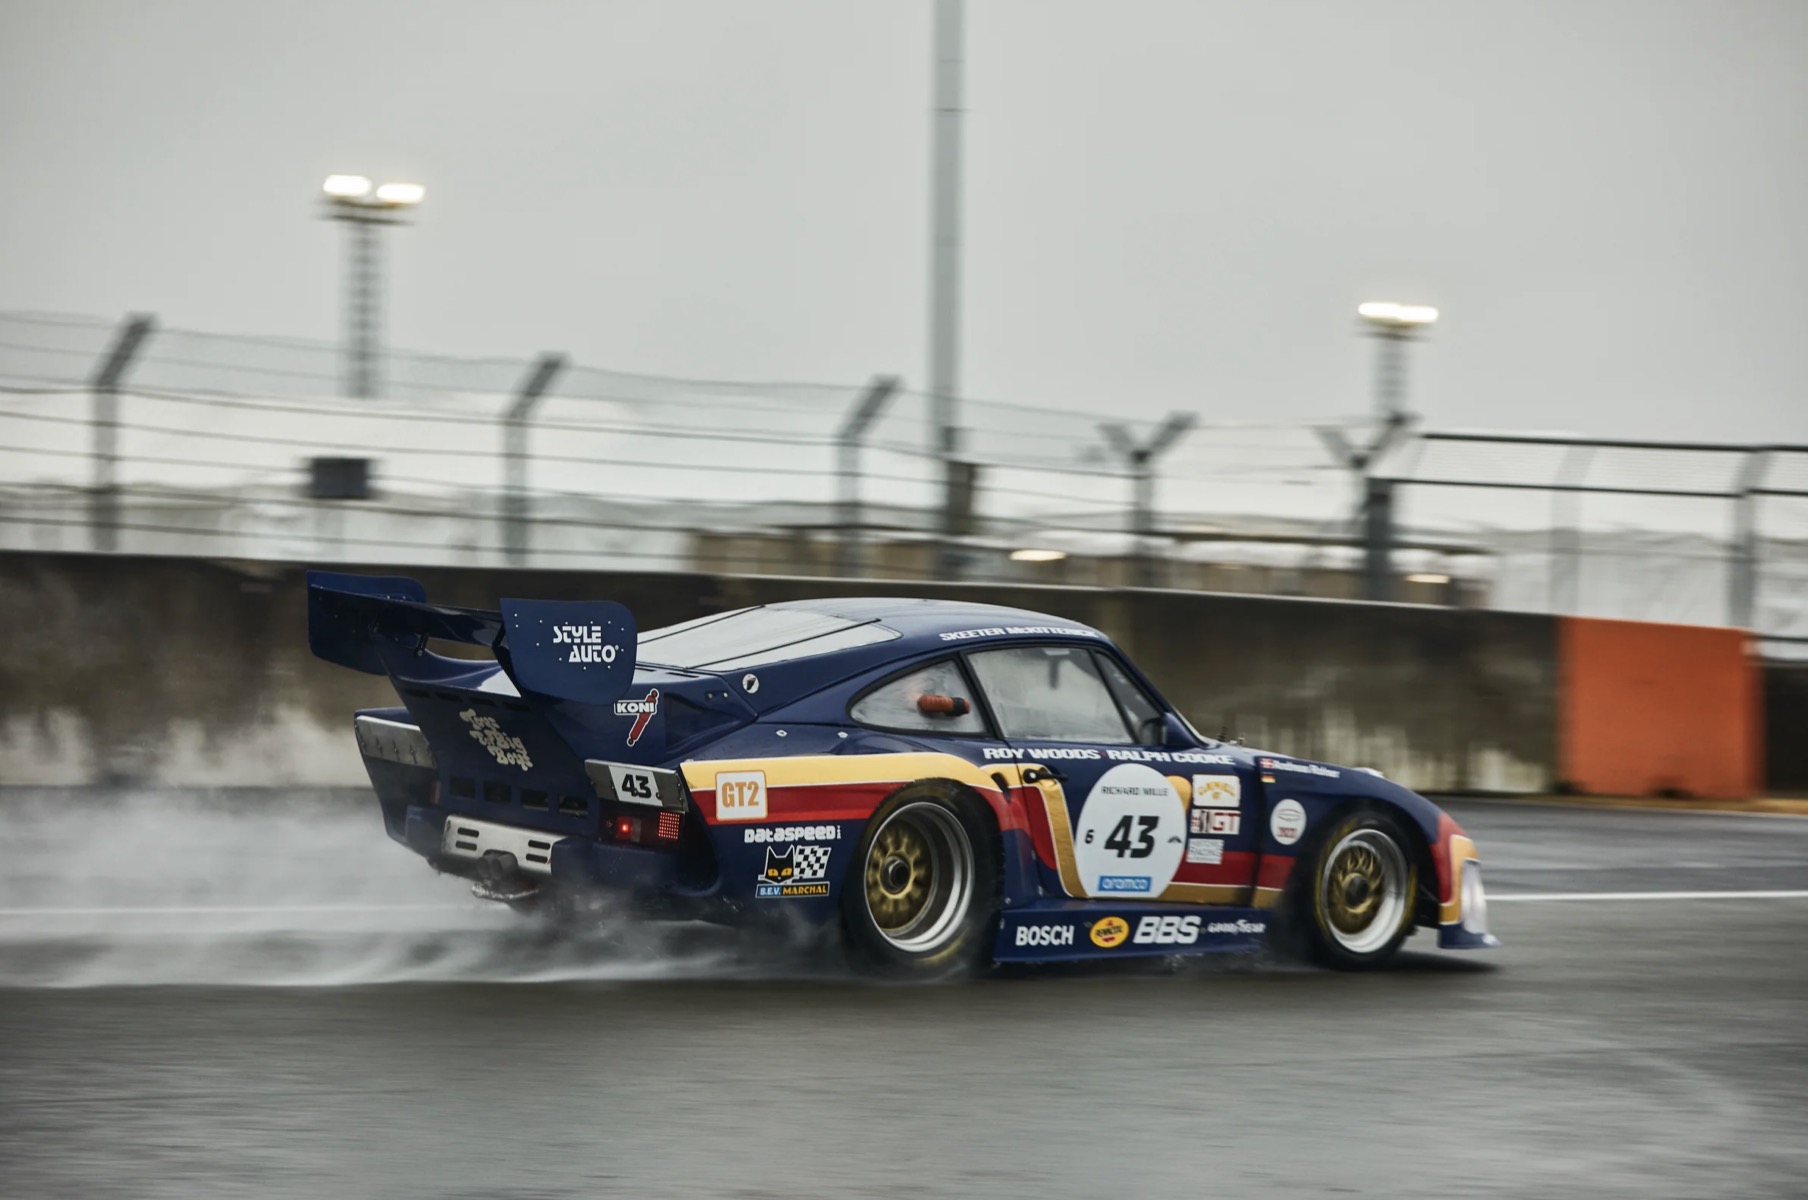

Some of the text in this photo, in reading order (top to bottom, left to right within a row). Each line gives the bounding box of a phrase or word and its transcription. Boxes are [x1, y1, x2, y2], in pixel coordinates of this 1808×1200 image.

[553, 626, 601, 643] STYLE
[939, 627, 1005, 641] SKEETER
[617, 702, 655, 713] KONI
[982, 747, 1236, 766] ROY WOODS RALPH COOKE
[621, 774, 652, 799] 43
[721, 781, 759, 808] GT2
[1101, 786, 1168, 797] RICHARD MILLE
[1085, 829, 1094, 844] 6
[1104, 815, 1159, 858] 43
[783, 884, 827, 895] MARCHAL
[1102, 878, 1148, 889] aramco
[1016, 925, 1074, 946] BOSCH
[1133, 916, 1201, 944] BBS
